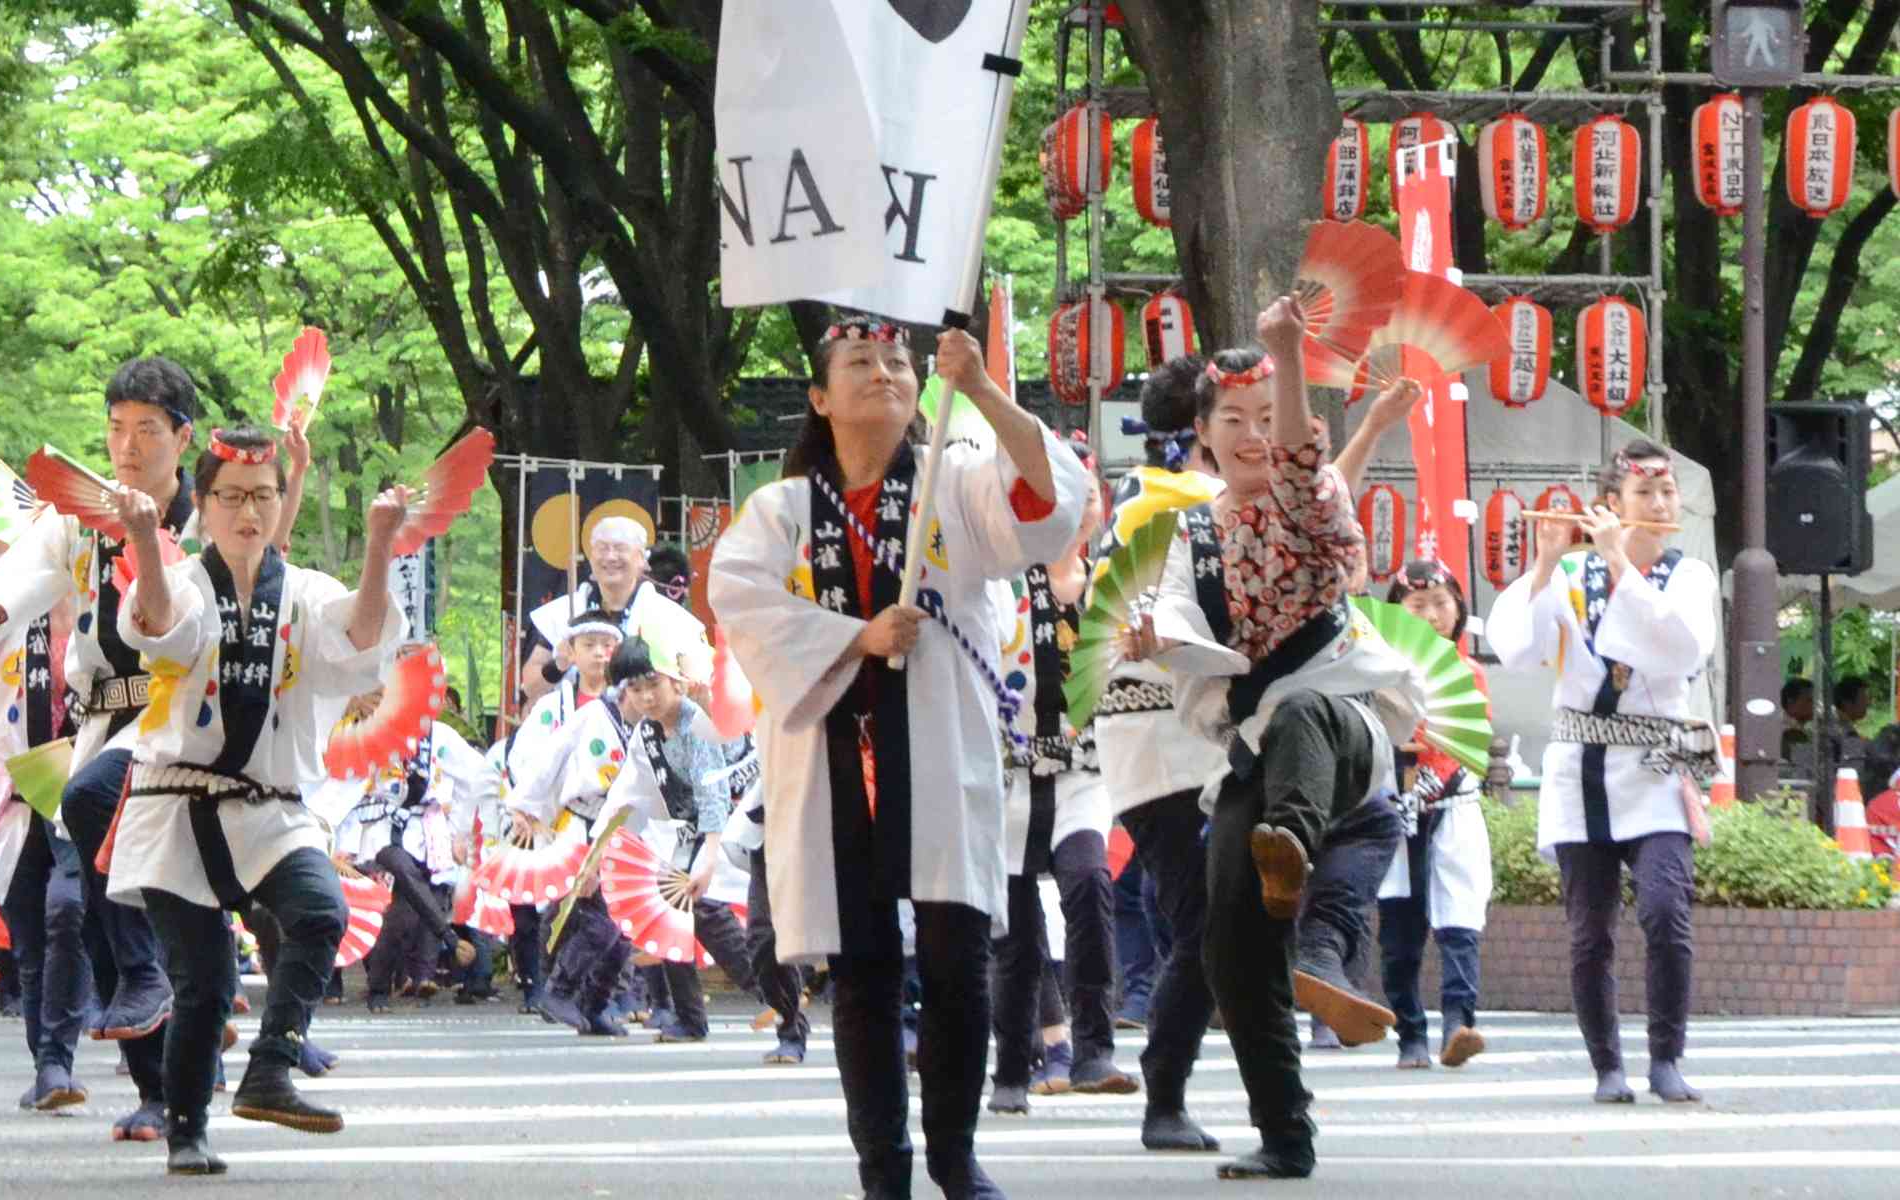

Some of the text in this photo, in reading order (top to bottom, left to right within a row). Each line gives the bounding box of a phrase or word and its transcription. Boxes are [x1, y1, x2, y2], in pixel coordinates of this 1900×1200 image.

[1593, 130, 1617, 216] 河北新報社
[1808, 113, 1833, 202] 東日本放送
[246, 601, 277, 687] 山雀絆
